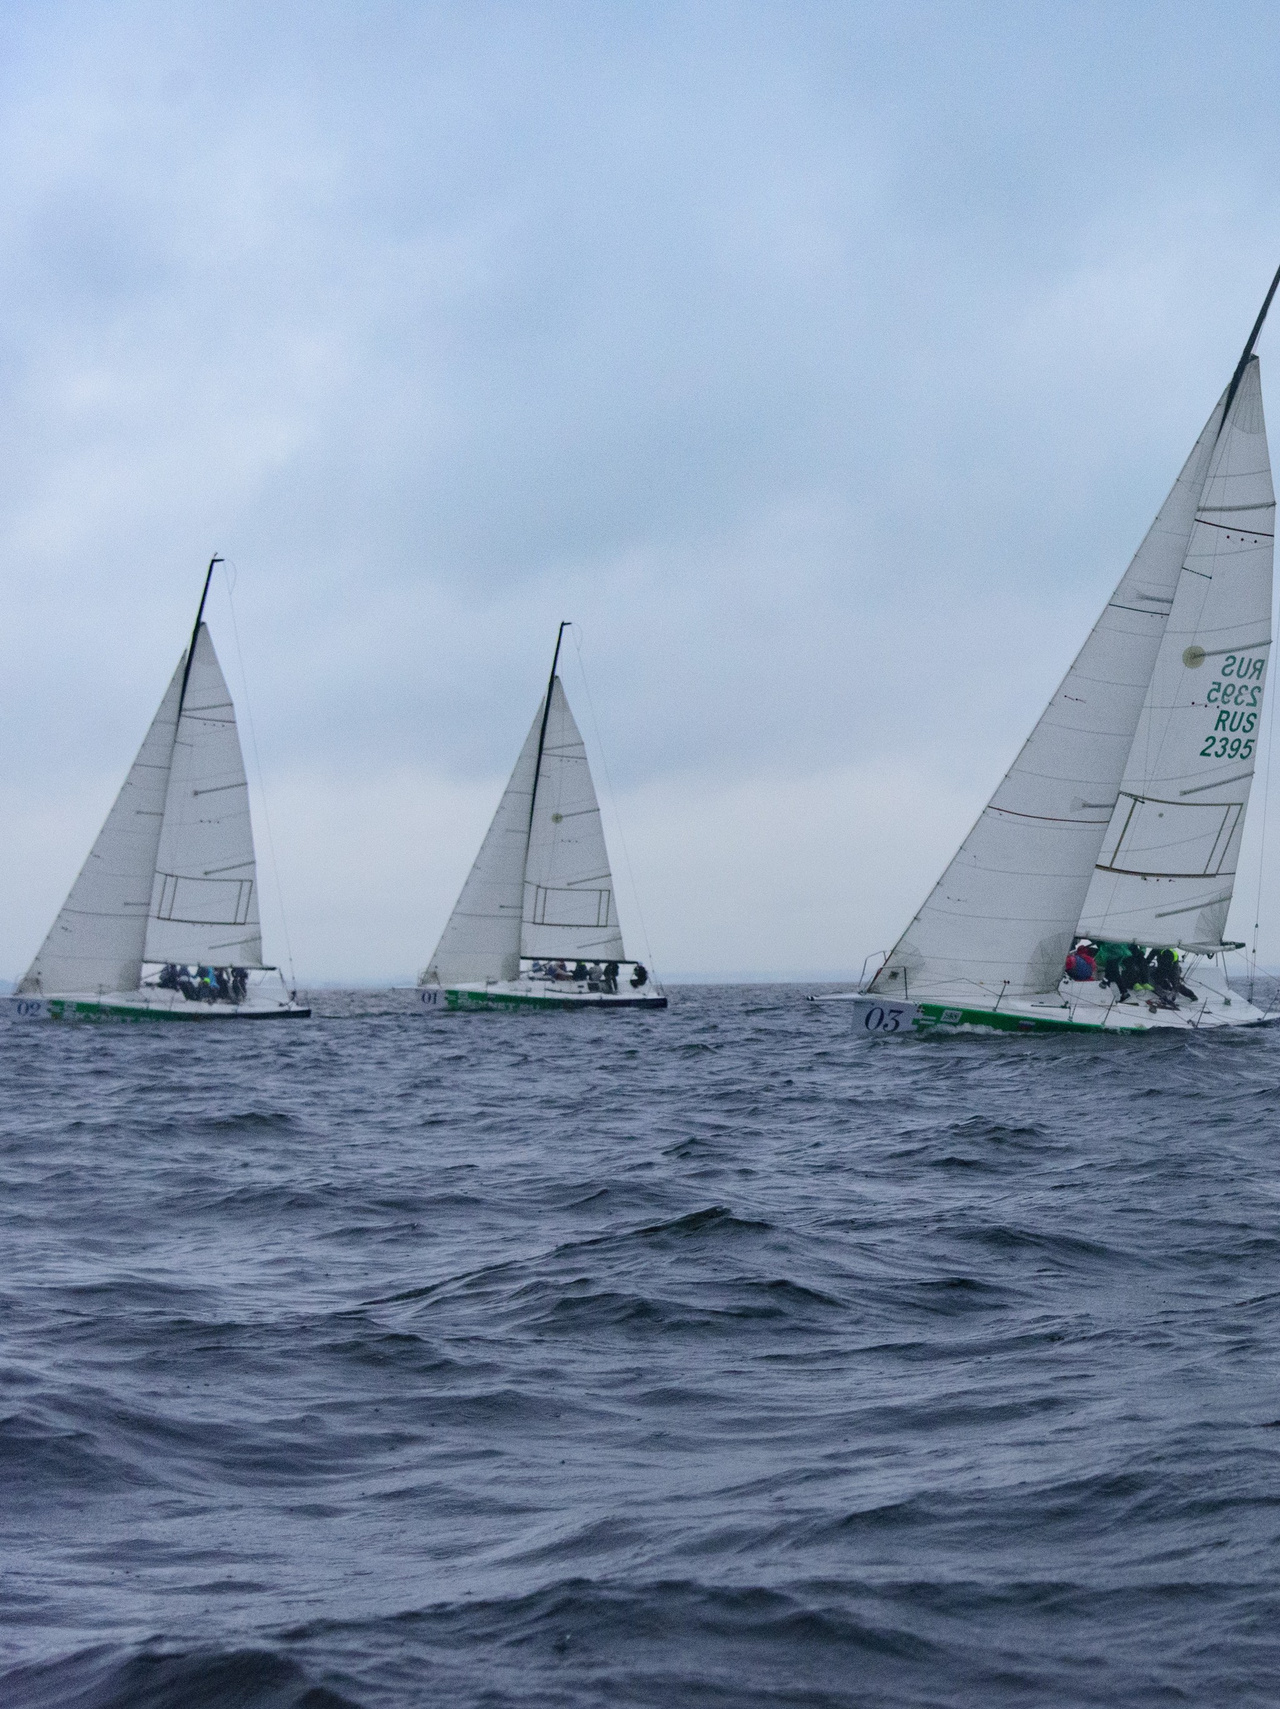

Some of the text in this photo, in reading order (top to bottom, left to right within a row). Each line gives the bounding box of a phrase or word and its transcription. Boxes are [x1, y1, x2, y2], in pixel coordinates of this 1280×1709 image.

[1214, 710, 1257, 733] RUS
[1199, 736, 1255, 760] 2395
[17, 1001, 41, 1017] 02
[421, 991, 437, 1005] 01
[865, 1007, 904, 1032] 03
